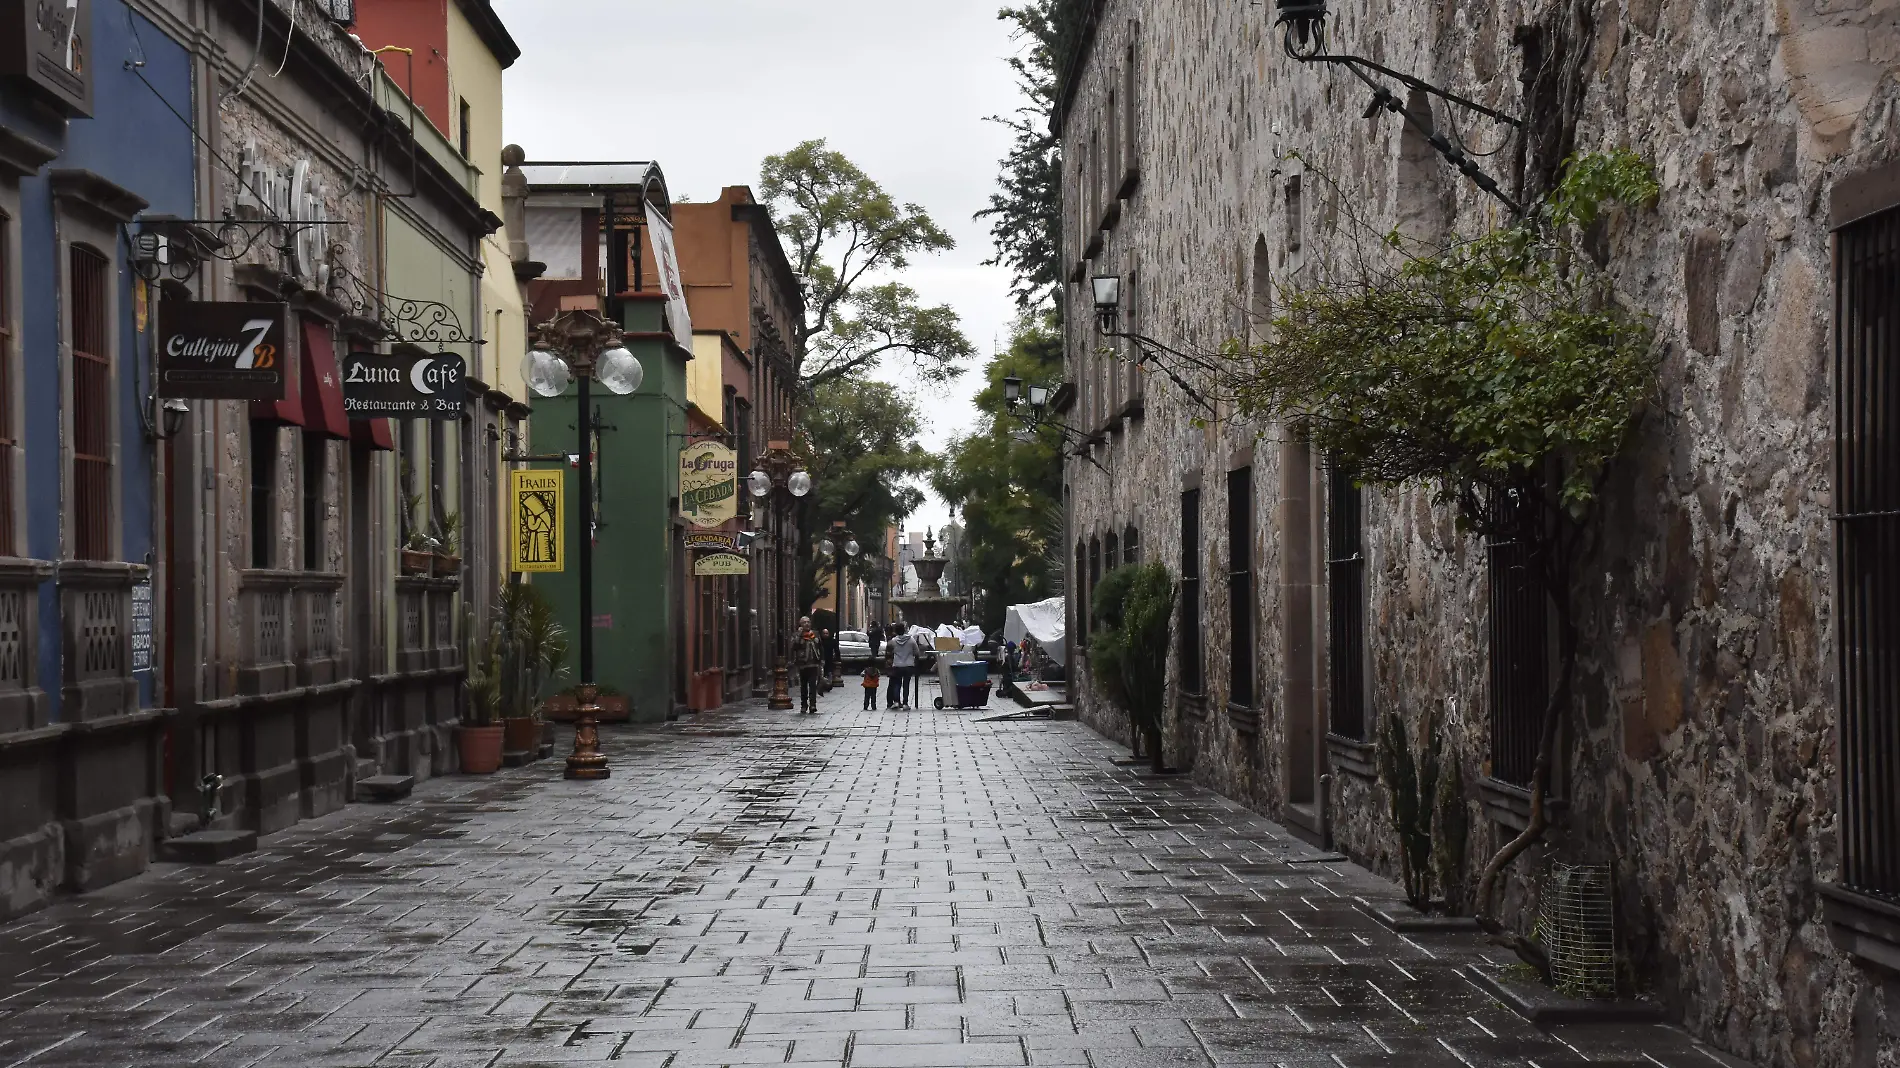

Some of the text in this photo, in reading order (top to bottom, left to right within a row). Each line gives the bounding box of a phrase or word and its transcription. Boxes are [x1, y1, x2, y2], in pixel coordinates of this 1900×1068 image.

[166, 334, 240, 362] Callejón
[345, 358, 461, 394] Luna Café
[344, 397, 416, 411] Restaurante
[435, 398, 461, 411] Bar
[682, 458, 694, 469] La
[519, 475, 557, 490] FRAILES
[695, 483, 733, 503] CEBADA
[686, 535, 732, 546] LEGENDARIA
[696, 554, 748, 567] RESTAURANTE
